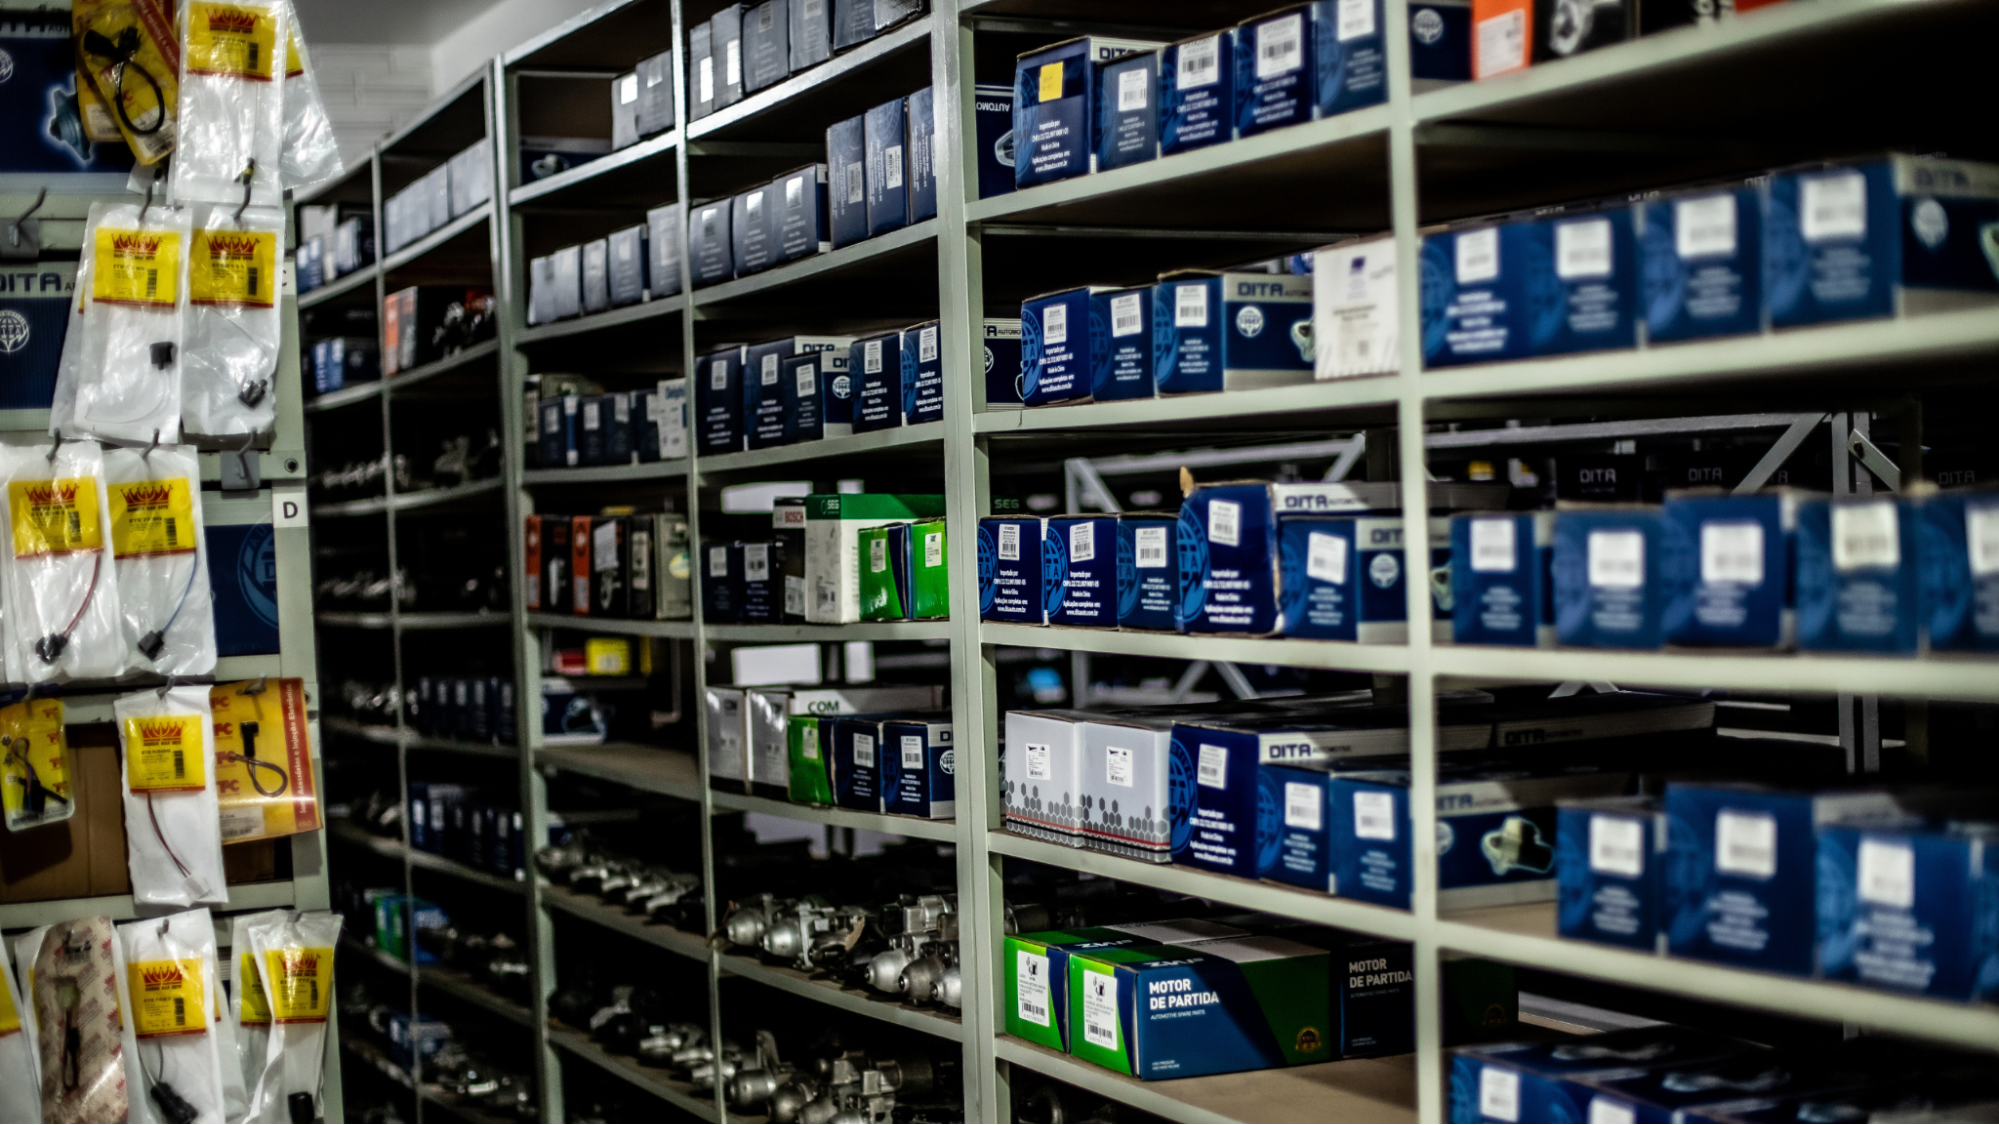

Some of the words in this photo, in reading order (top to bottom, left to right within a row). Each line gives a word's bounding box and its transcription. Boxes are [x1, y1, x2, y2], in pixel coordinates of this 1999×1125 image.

[1238, 282, 1283, 296] DITA
[1579, 469, 1616, 483] DITA
[1688, 468, 1723, 482] DITA
[827, 500, 839, 510] SEG
[994, 499, 1020, 509] SEG
[1285, 496, 1328, 508] DITA
[282, 502, 298, 518] D
[808, 700, 839, 713] COM
[1270, 744, 1311, 758] DITA
[294, 758, 304, 795] Acessórios
[1349, 958, 1387, 973] MOTOR
[1350, 976, 1364, 988] DE
[1366, 970, 1413, 987] PARTIDA
[1149, 978, 1191, 995] MOTOR
[1150, 997, 1166, 1010] DE
[1168, 991, 1219, 1008] PARTIDA
[1150, 1012, 1177, 1020] AUTOMOTIVE
[1178, 1010, 1192, 1018] SPARE
